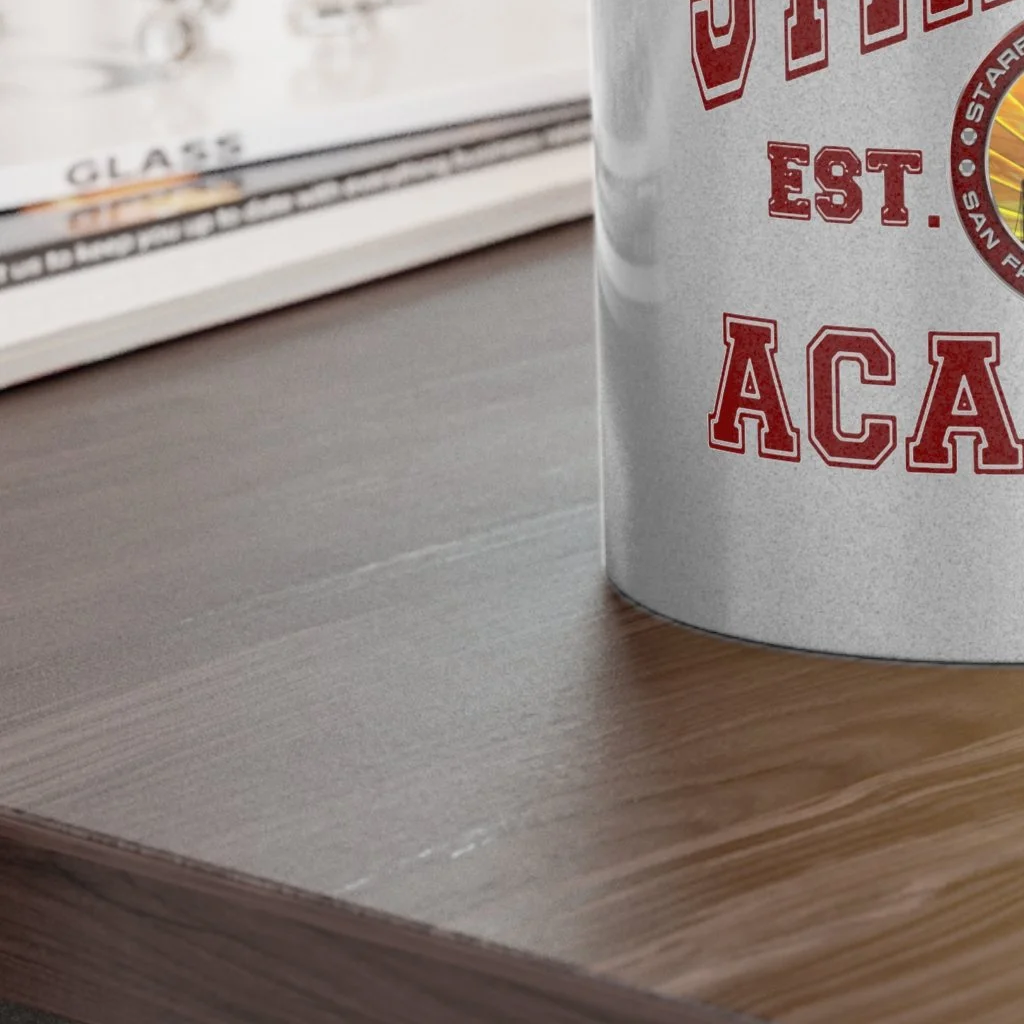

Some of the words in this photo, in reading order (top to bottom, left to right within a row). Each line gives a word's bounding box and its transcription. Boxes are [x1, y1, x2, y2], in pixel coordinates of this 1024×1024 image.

[67, 131, 242, 185] GLASS
[767, 141, 940, 227] EST.
[963, 190, 1001, 250] SAN
